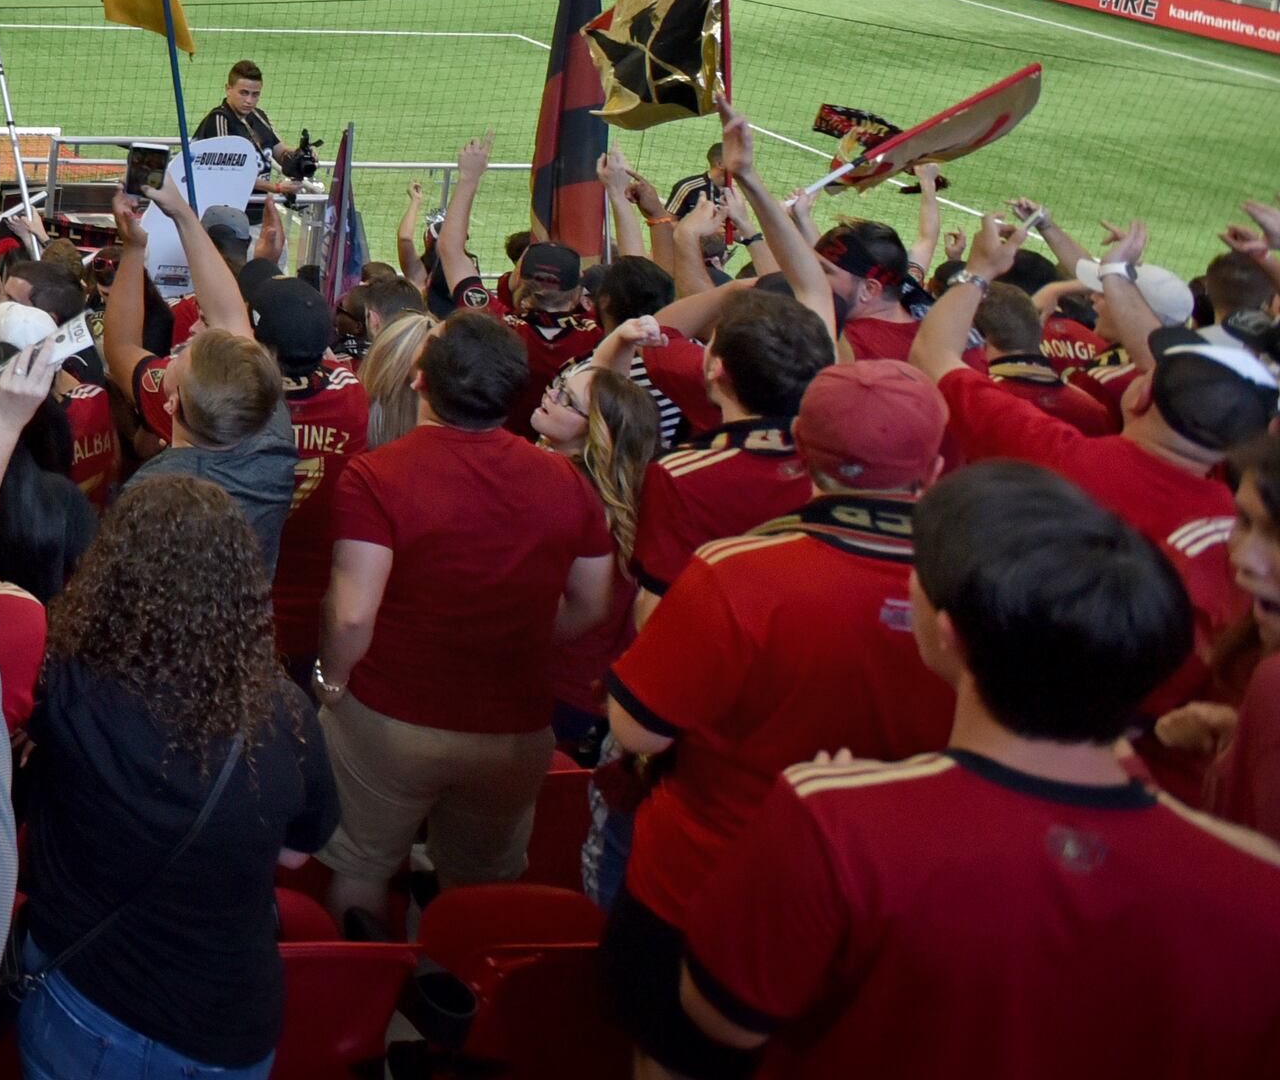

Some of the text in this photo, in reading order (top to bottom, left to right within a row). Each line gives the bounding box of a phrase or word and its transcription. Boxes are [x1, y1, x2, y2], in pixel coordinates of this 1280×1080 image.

[194, 151, 248, 168] #BUILDAHEAD
[73, 431, 112, 465] ALBA
[292, 424, 351, 455] TINEZ
